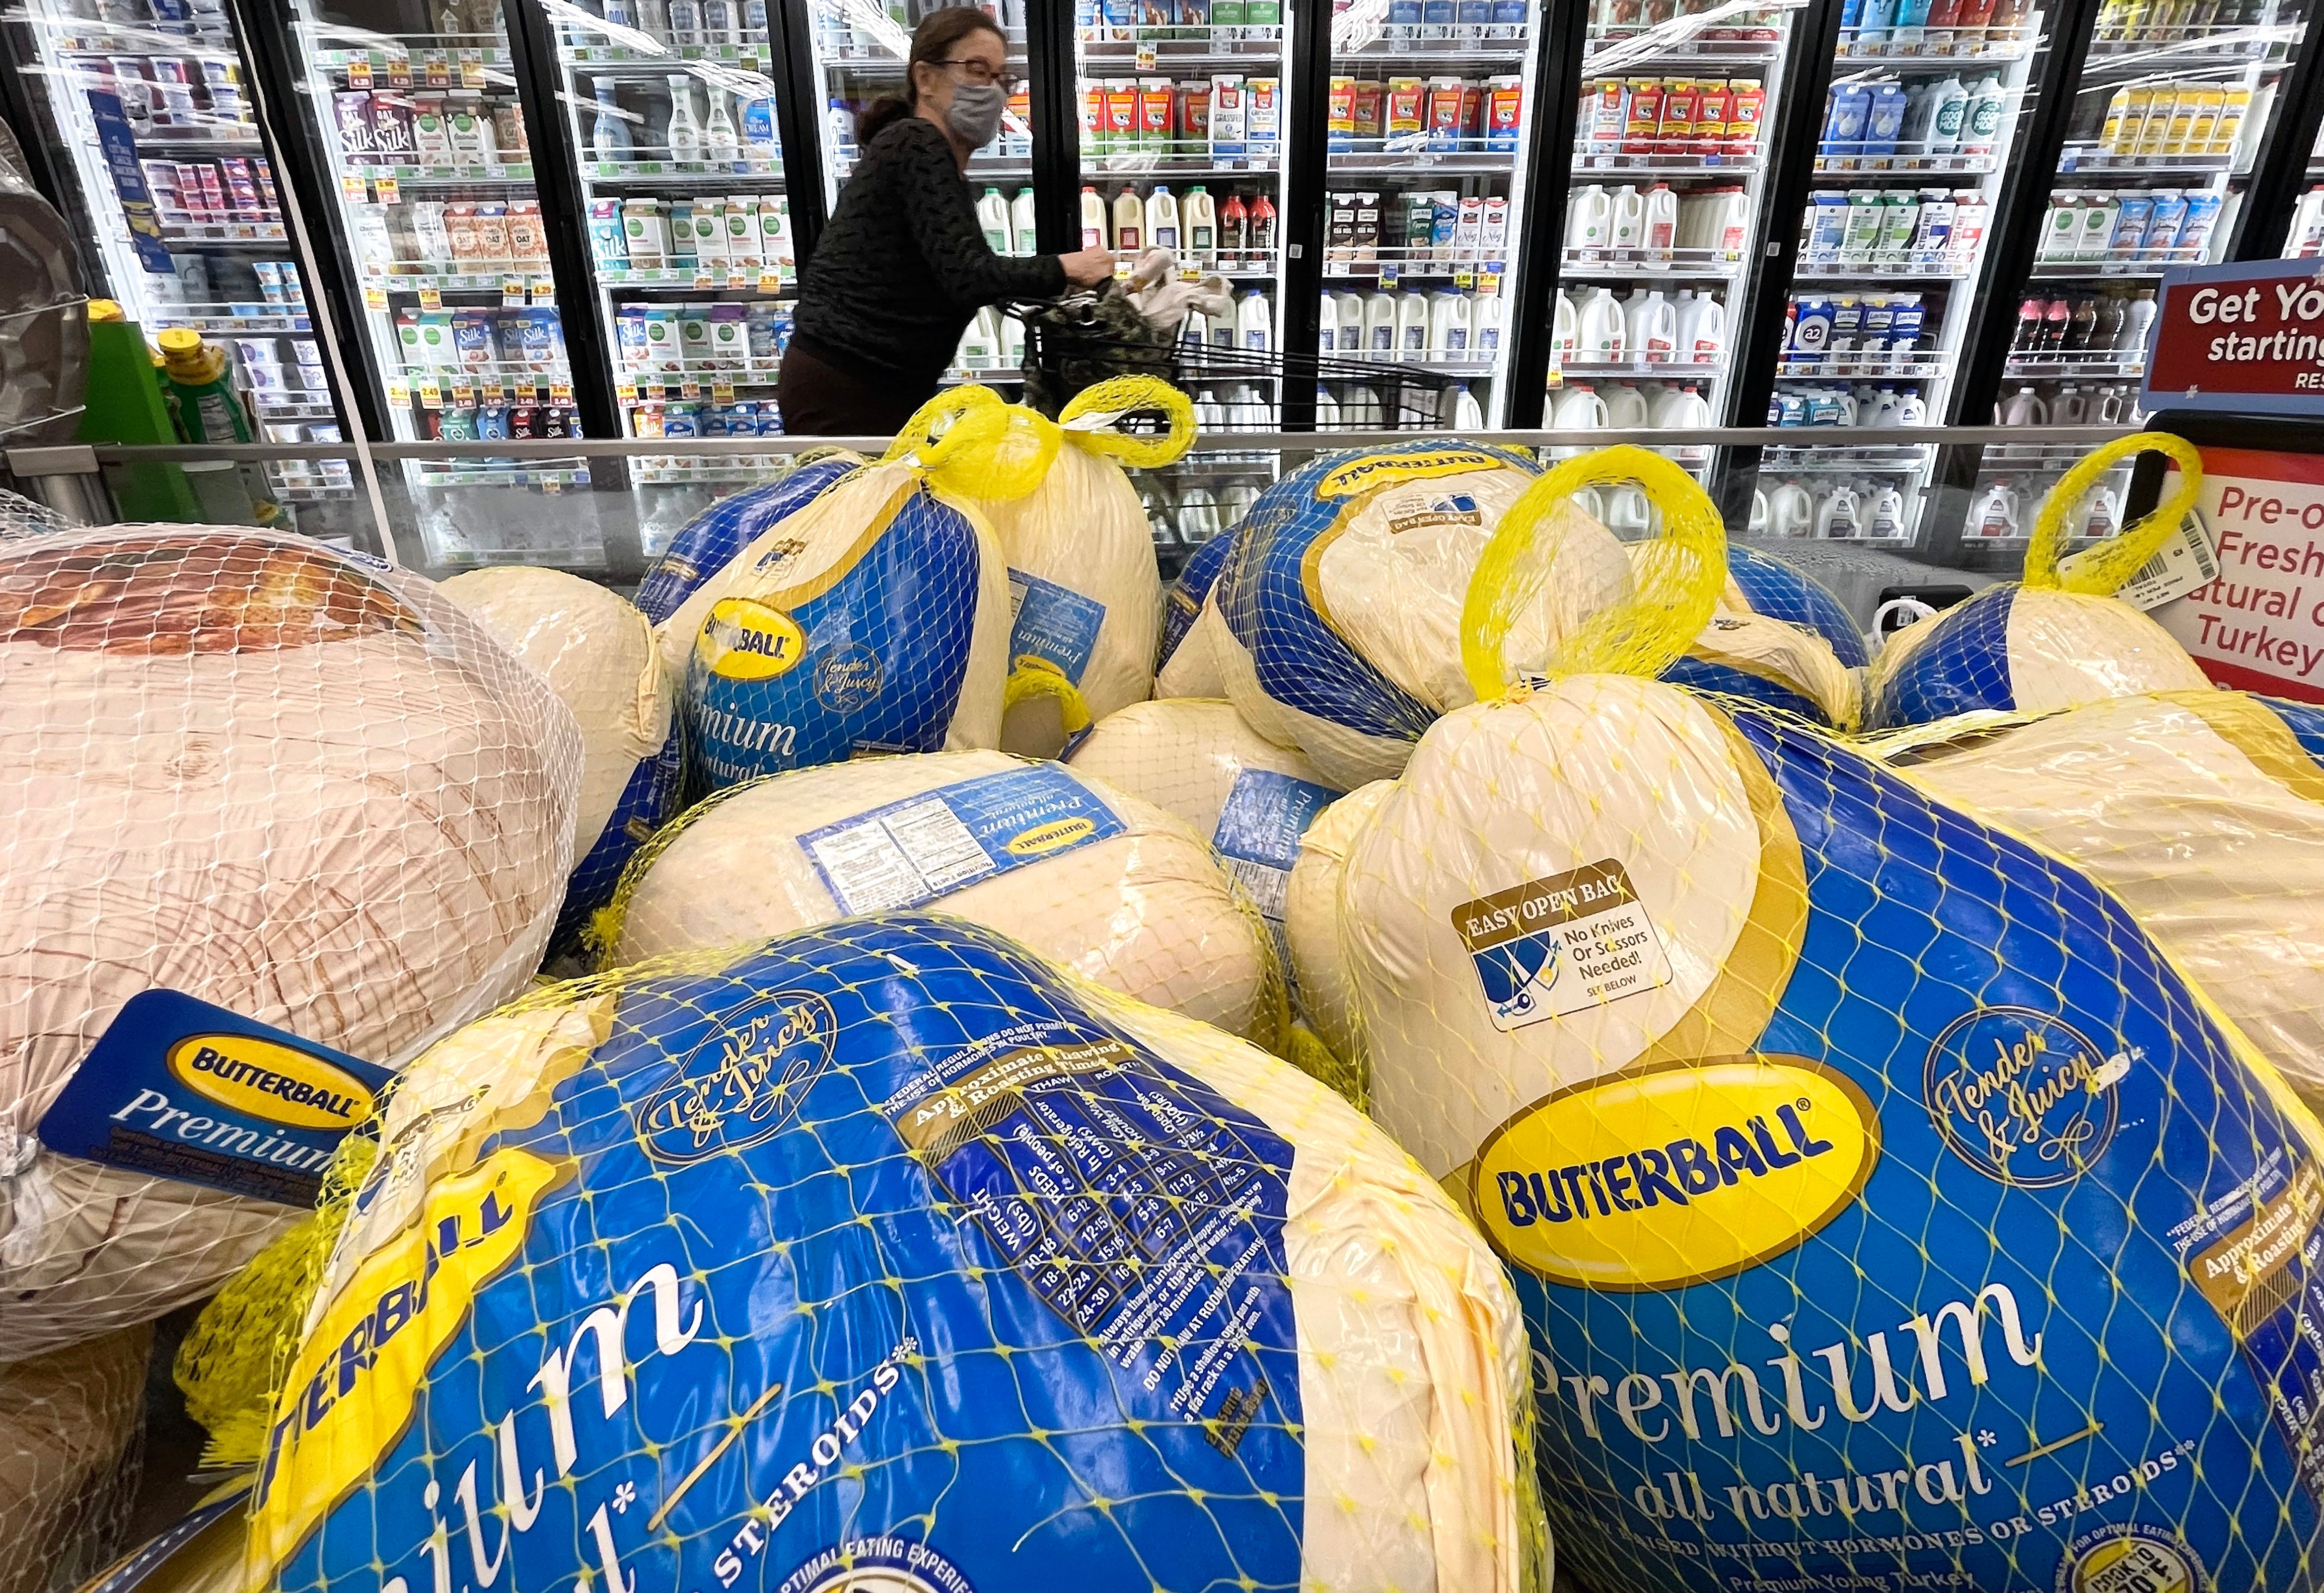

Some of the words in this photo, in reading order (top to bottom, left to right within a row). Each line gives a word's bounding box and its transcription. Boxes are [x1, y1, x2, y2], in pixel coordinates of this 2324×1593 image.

[340, 128, 374, 151] Silk
[375, 128, 409, 152] Silk
[592, 234, 626, 257] Silk
[2189, 287, 2260, 324] Get
[2276, 283, 2324, 320] Yo
[459, 327, 482, 344] Silk
[523, 326, 546, 343] Silk
[623, 324, 644, 340] Silk
[1805, 328, 1821, 339] a2
[2218, 486, 2324, 529] Pre-o
[2217, 531, 2324, 578] Fresh
[2187, 575, 2302, 619] atural
[2198, 614, 2324, 676] Turkey
[982, 796, 1084, 834] Premium
[1015, 822, 1088, 851] BUTTERBALL
[1466, 905, 1518, 937] EASY
[1522, 887, 1578, 920] OPEN
[1564, 929, 1588, 945] No
[1591, 916, 1634, 938] Knives
[1573, 947, 1591, 961] Or
[1579, 950, 1642, 980] Needed!
[1605, 975, 1637, 992] BELOW
[936, 1031, 1001, 1070] REGULAONS
[1001, 1027, 1015, 1037] DO
[1016, 1024, 1035, 1035] NOT
[192, 1046, 354, 1119] BUTTERBALL
[648, 1014, 769, 1129] Tender
[689, 1099, 726, 1147] &
[725, 1005, 824, 1113] Juicy
[1936, 1031, 2038, 1123] Tender
[949, 1101, 968, 1119] &
[967, 1063, 1057, 1106] Roasting
[1148, 1091, 1189, 1126] (HOURS)
[1978, 1110, 2017, 1163] &
[2008, 1052, 2094, 1143] Juicy
[1013, 1123, 1056, 1163] people)
[1036, 1101, 1090, 1159] Refrigerator
[1077, 1127, 1113, 1158] (DAYS)
[1101, 1118, 1124, 1138] Cold
[1047, 1160, 1065, 1175] of
[1088, 1154, 1102, 1172] In
[1106, 1164, 1127, 1186] 3-4
[1155, 1160, 1177, 1176] 9-11
[1028, 1166, 1065, 1205] FEEDS
[1123, 1180, 1143, 1202] 4-5
[1169, 1173, 1196, 1195] 11-12
[971, 1187, 1021, 1251] WEIGHT
[1006, 1201, 1037, 1237] (lbs)
[1067, 1199, 1091, 1222] 6-12
[1137, 1198, 1160, 1222] 5-6
[1183, 1191, 1209, 1215] 12-15
[1081, 1216, 1109, 1243] 12-15
[1155, 1217, 1174, 1239] 6-7
[2204, 1203, 2293, 1279] Approximate
[1058, 1270, 1091, 1306] 22-24
[1098, 1308, 1132, 1347] Always
[1126, 1290, 1149, 1311] thaw
[1153, 1238, 1194, 1286] unopened
[1106, 1344, 1122, 1360] in
[1118, 1299, 1163, 1347] refrigeror,
[1158, 1288, 1170, 1302] or
[1166, 1259, 1192, 1290] thaw
[1187, 1252, 1200, 1264] in
[1207, 1224, 1233, 1247] water,
[2235, 1264, 2248, 1286] &
[1077, 1287, 1110, 1324] 24-30
[1120, 1336, 1146, 1369] water
[1159, 1306, 1173, 1321] 30
[1169, 1268, 1207, 1312] minutes.
[1143, 1369, 1162, 1391] DO
[1154, 1347, 1175, 1373] NOT
[1173, 1326, 1194, 1350] HAW
[1188, 1316, 1204, 1333] AT
[1198, 1284, 1225, 1319] ROOM
[1189, 1370, 1200, 1382] a
[1195, 1338, 1226, 1370] shallow
[1533, 1282, 2041, 1444] Premium
[1184, 1412, 1194, 1424] a
[1201, 1365, 1221, 1394] rack
[1215, 1356, 1228, 1372] in
[1223, 1349, 1234, 1361] a
[381, 1263, 702, 1593] ium
[1634, 1471, 1715, 1521] all
[847, 1538, 904, 1558] EATING
[1705, 1542, 1817, 1559] WITHOUT
[1820, 1527, 1984, 1556] HORMONES
[1990, 1516, 2033, 1540] OR
[2071, 1535, 2092, 1553] FOR
[2143, 1524, 2180, 1544] EATIN
[1730, 1574, 1819, 1593] Premium
[1820, 1572, 1891, 1593] Young
[1891, 1570, 1975, 1593] Turkey
